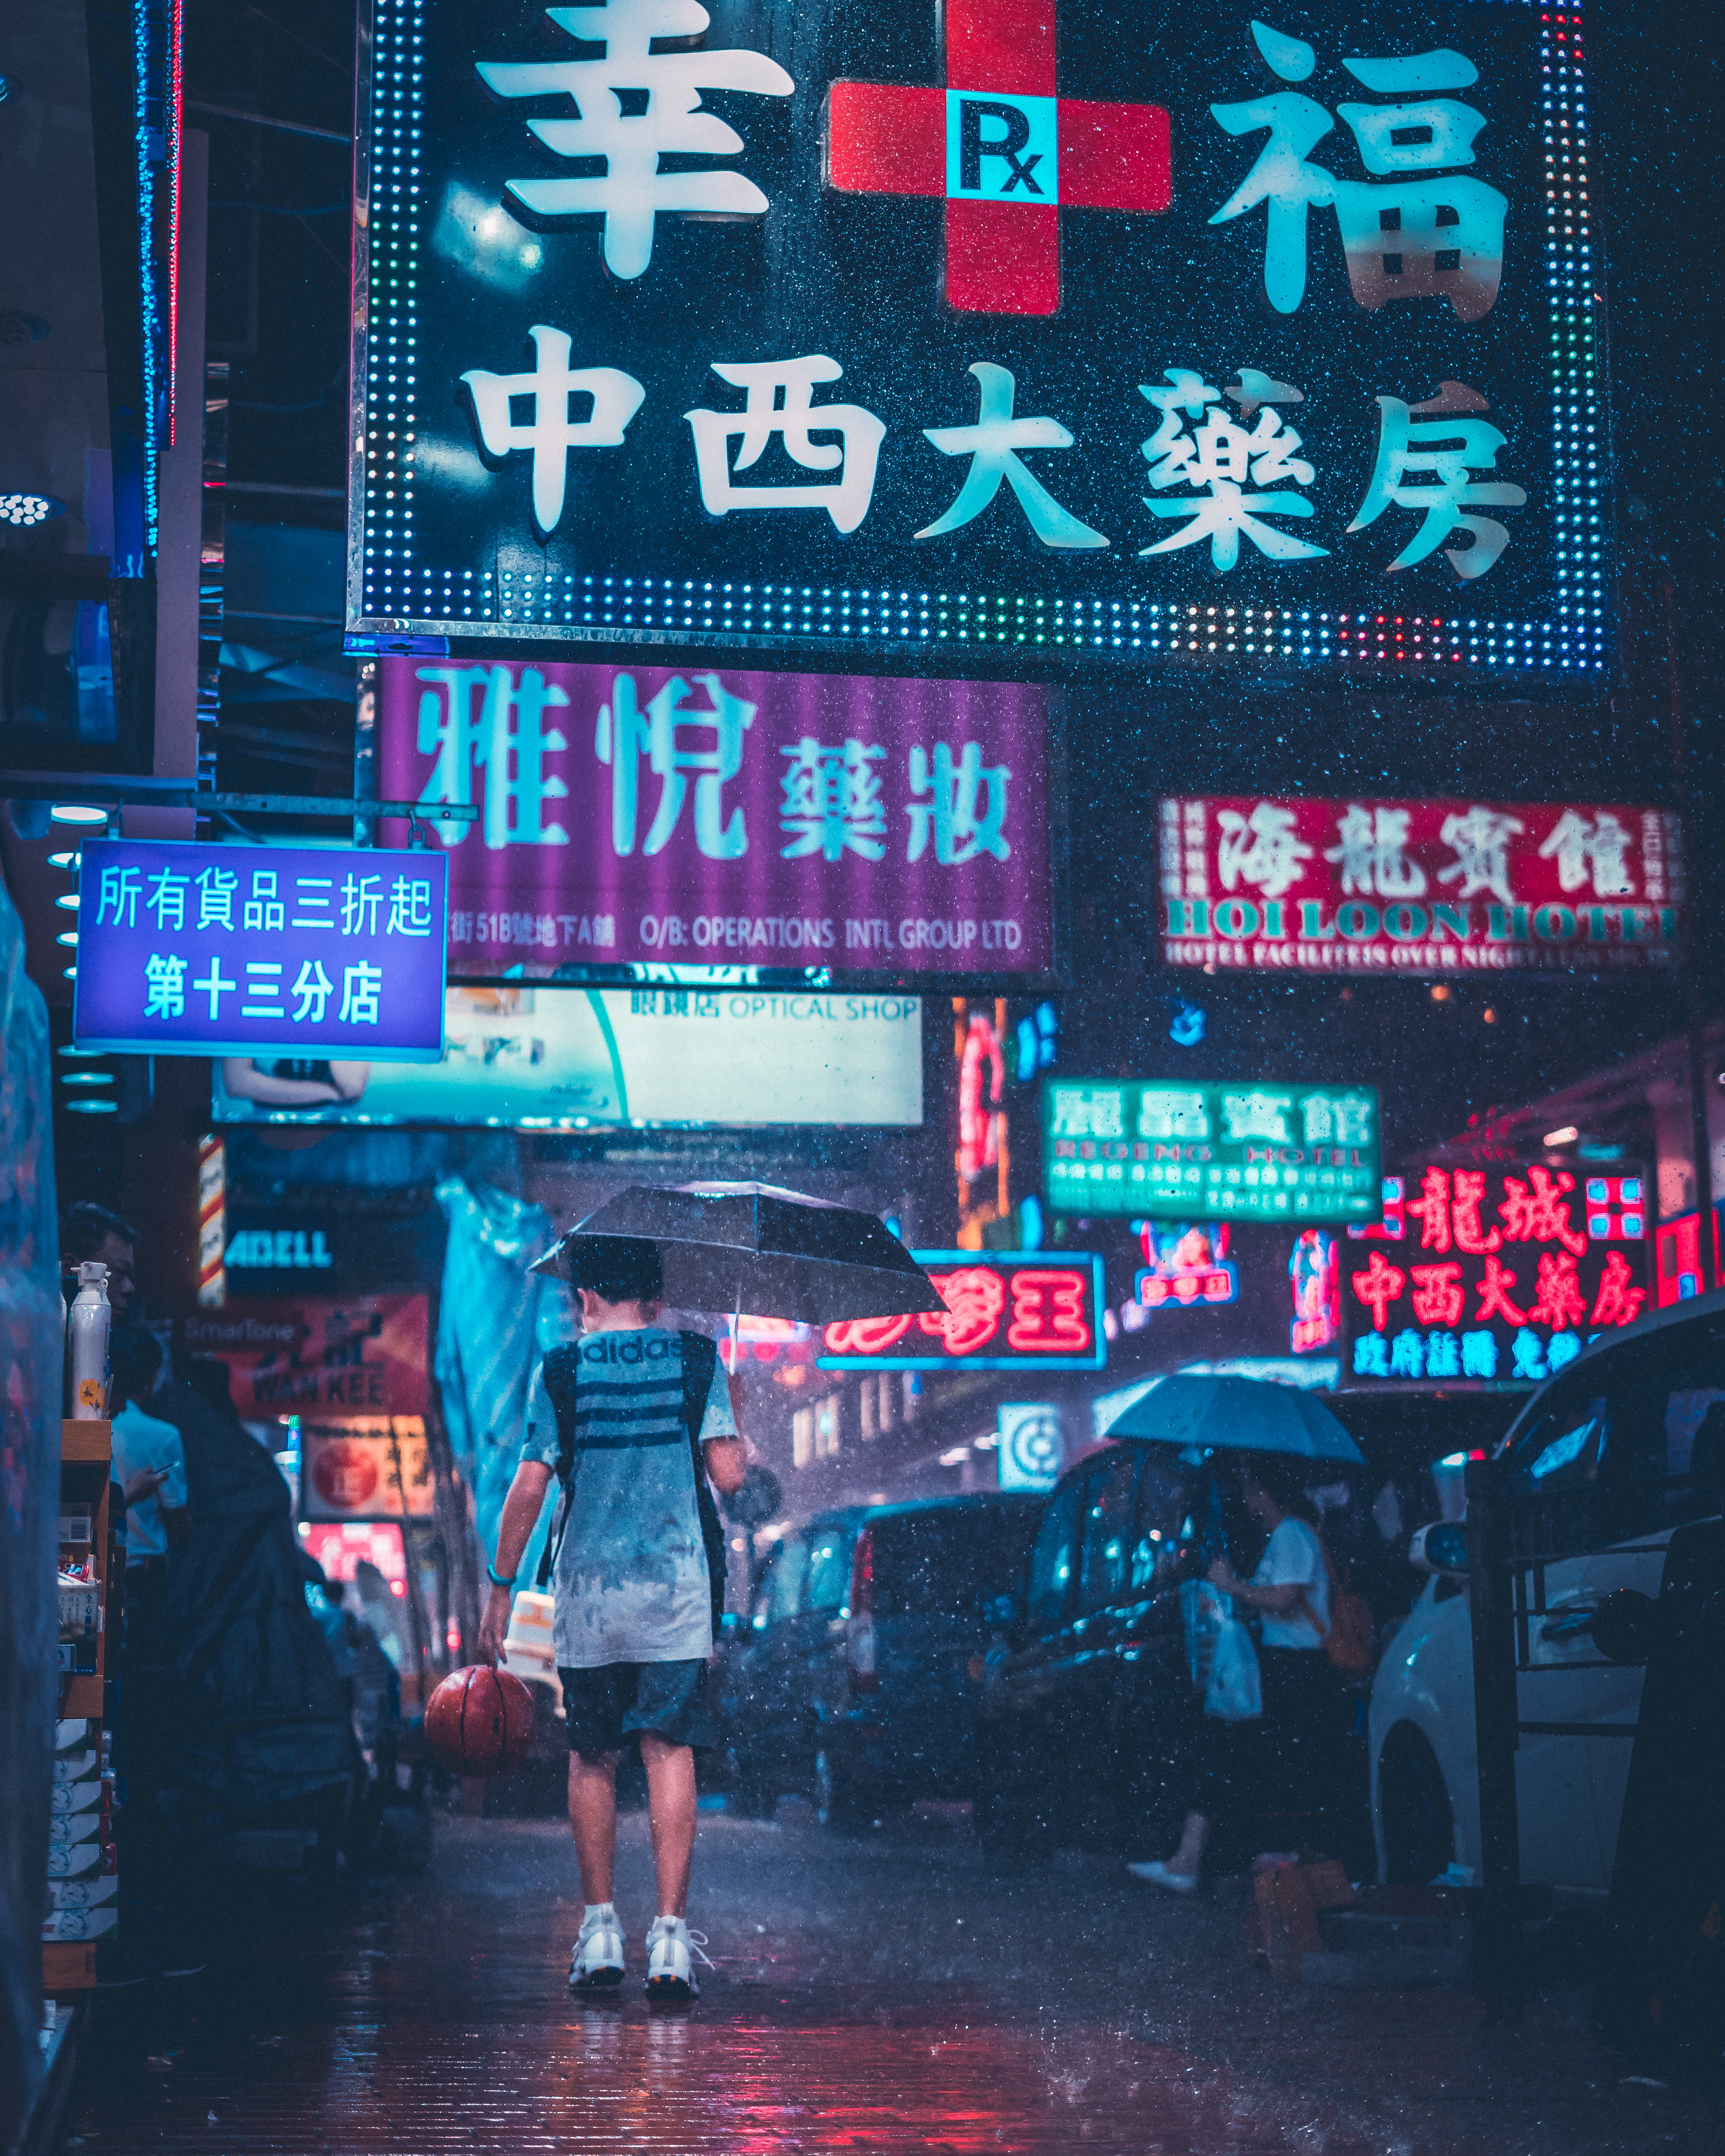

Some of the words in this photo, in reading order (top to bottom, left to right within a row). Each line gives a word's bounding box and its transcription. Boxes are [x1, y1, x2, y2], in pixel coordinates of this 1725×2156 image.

[473, 0, 795, 280] 幸
[959, 98, 1045, 195] Rx
[1208, 18, 1509, 322] 福
[460, 323, 1528, 579] 中西大藥房
[95, 865, 433, 938] 所有貨品三折起
[692, 915, 835, 948] OPERATIONS
[898, 918, 977, 950] GROUP
[981, 920, 1021, 951] LTD
[1166, 897, 1288, 941] HOI
[1298, 899, 1472, 942] LOON
[142, 952, 382, 1025] 第十三分店
[729, 997, 838, 1021] OPTICAL
[846, 998, 918, 1023] SHOP
[1405, 1165, 1588, 1257] 龍城
[1351, 1250, 1648, 1332] 中西大藥房
[578, 1334, 688, 1364] didas
